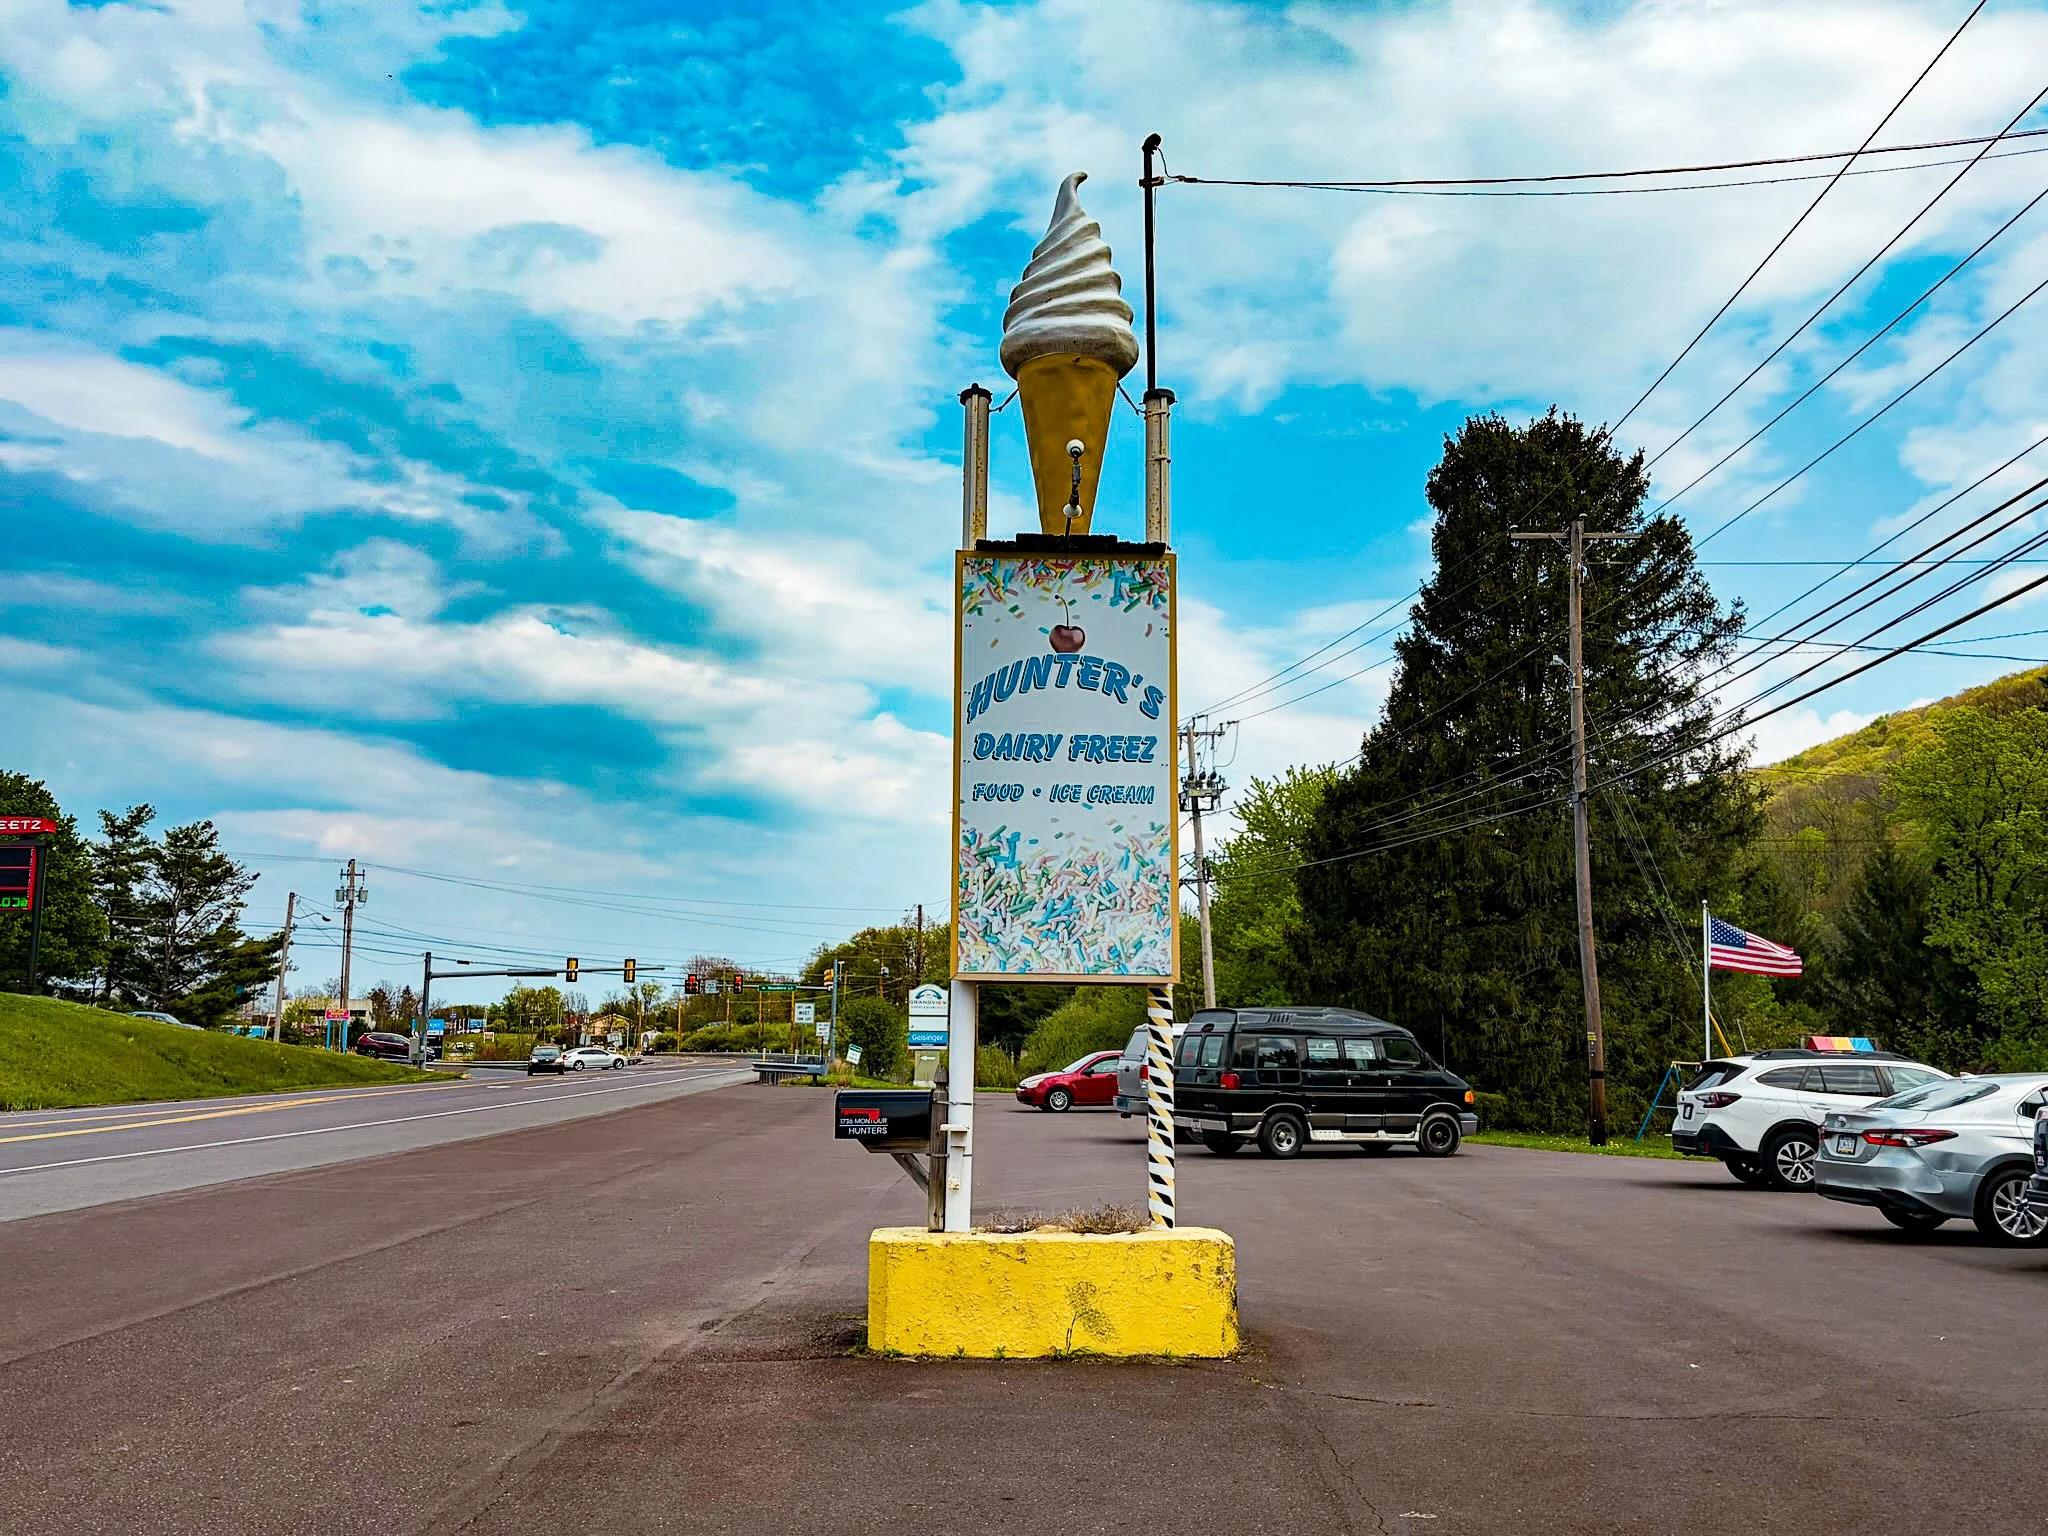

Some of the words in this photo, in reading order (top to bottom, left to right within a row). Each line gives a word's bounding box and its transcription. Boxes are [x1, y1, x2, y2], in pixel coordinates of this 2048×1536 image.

[967, 653, 1165, 724] HUNTER'S
[973, 733, 1063, 763] DAIRY
[1068, 735, 1158, 764] FREEZ
[973, 783, 1024, 802] FOOD
[1049, 784, 1083, 803] ICE
[1087, 785, 1155, 805] CREAM
[911, 1033, 944, 1042] Geisinger
[848, 1127, 888, 1135] HUNTERS
